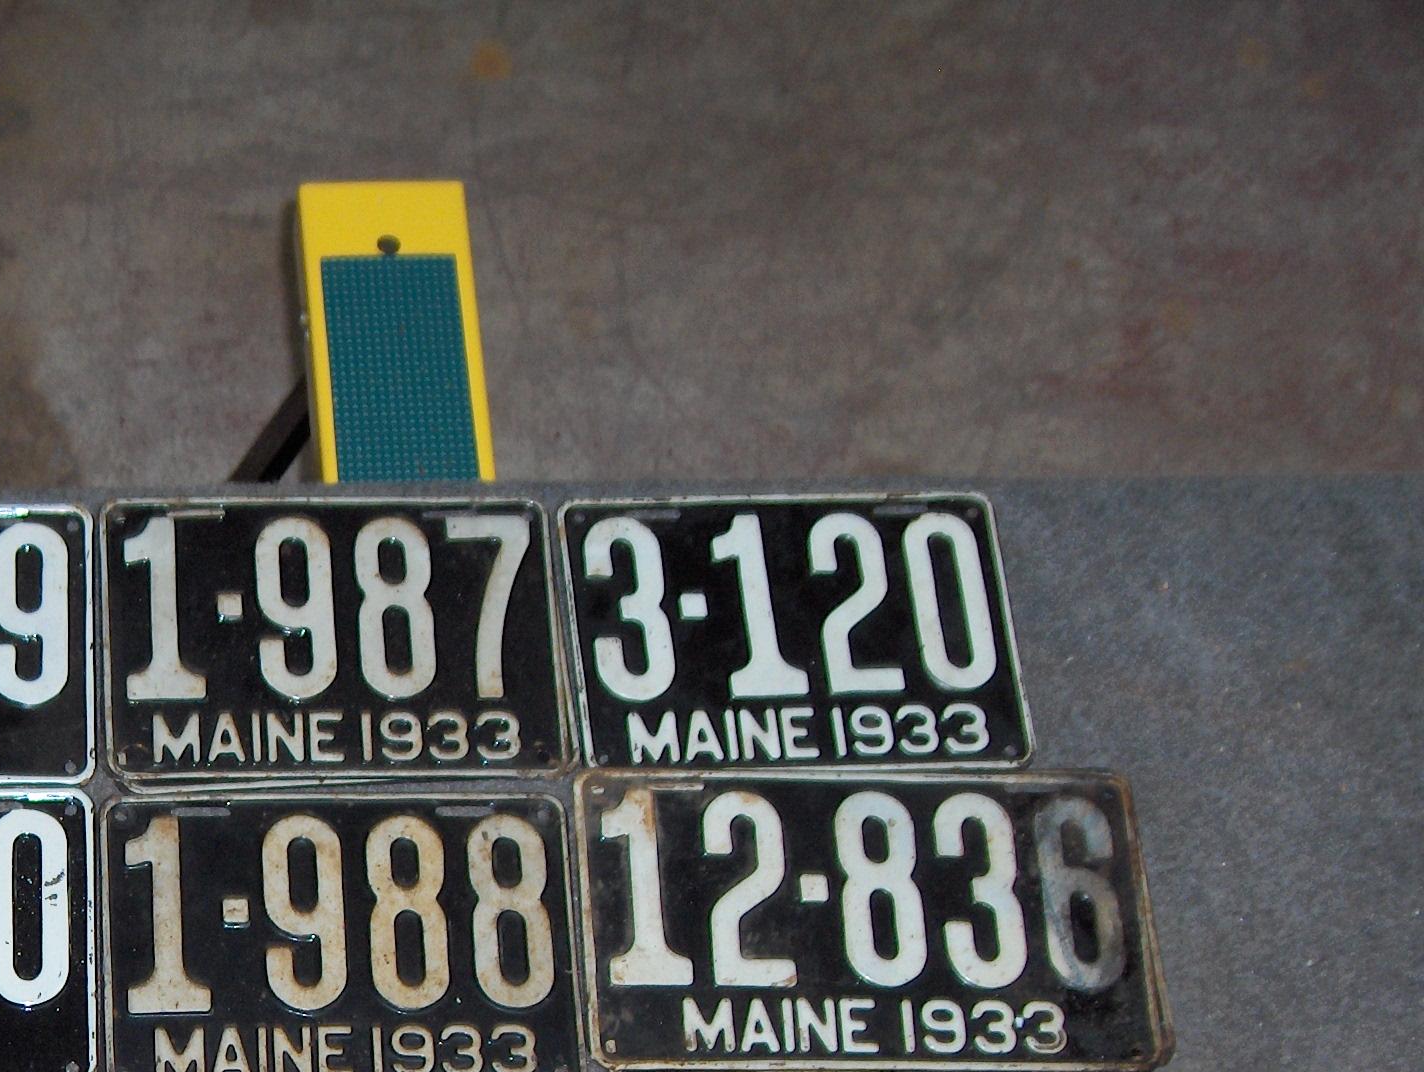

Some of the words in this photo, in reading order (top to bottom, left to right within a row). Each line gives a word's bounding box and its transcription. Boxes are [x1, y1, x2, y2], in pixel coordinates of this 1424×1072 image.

[152, 711, 345, 765] MAINE
[360, 710, 521, 763] 1933
[627, 706, 820, 764] MAINE
[833, 702, 990, 758] 1933
[682, 997, 880, 1053] MAINE
[904, 999, 1068, 1054] 1933
